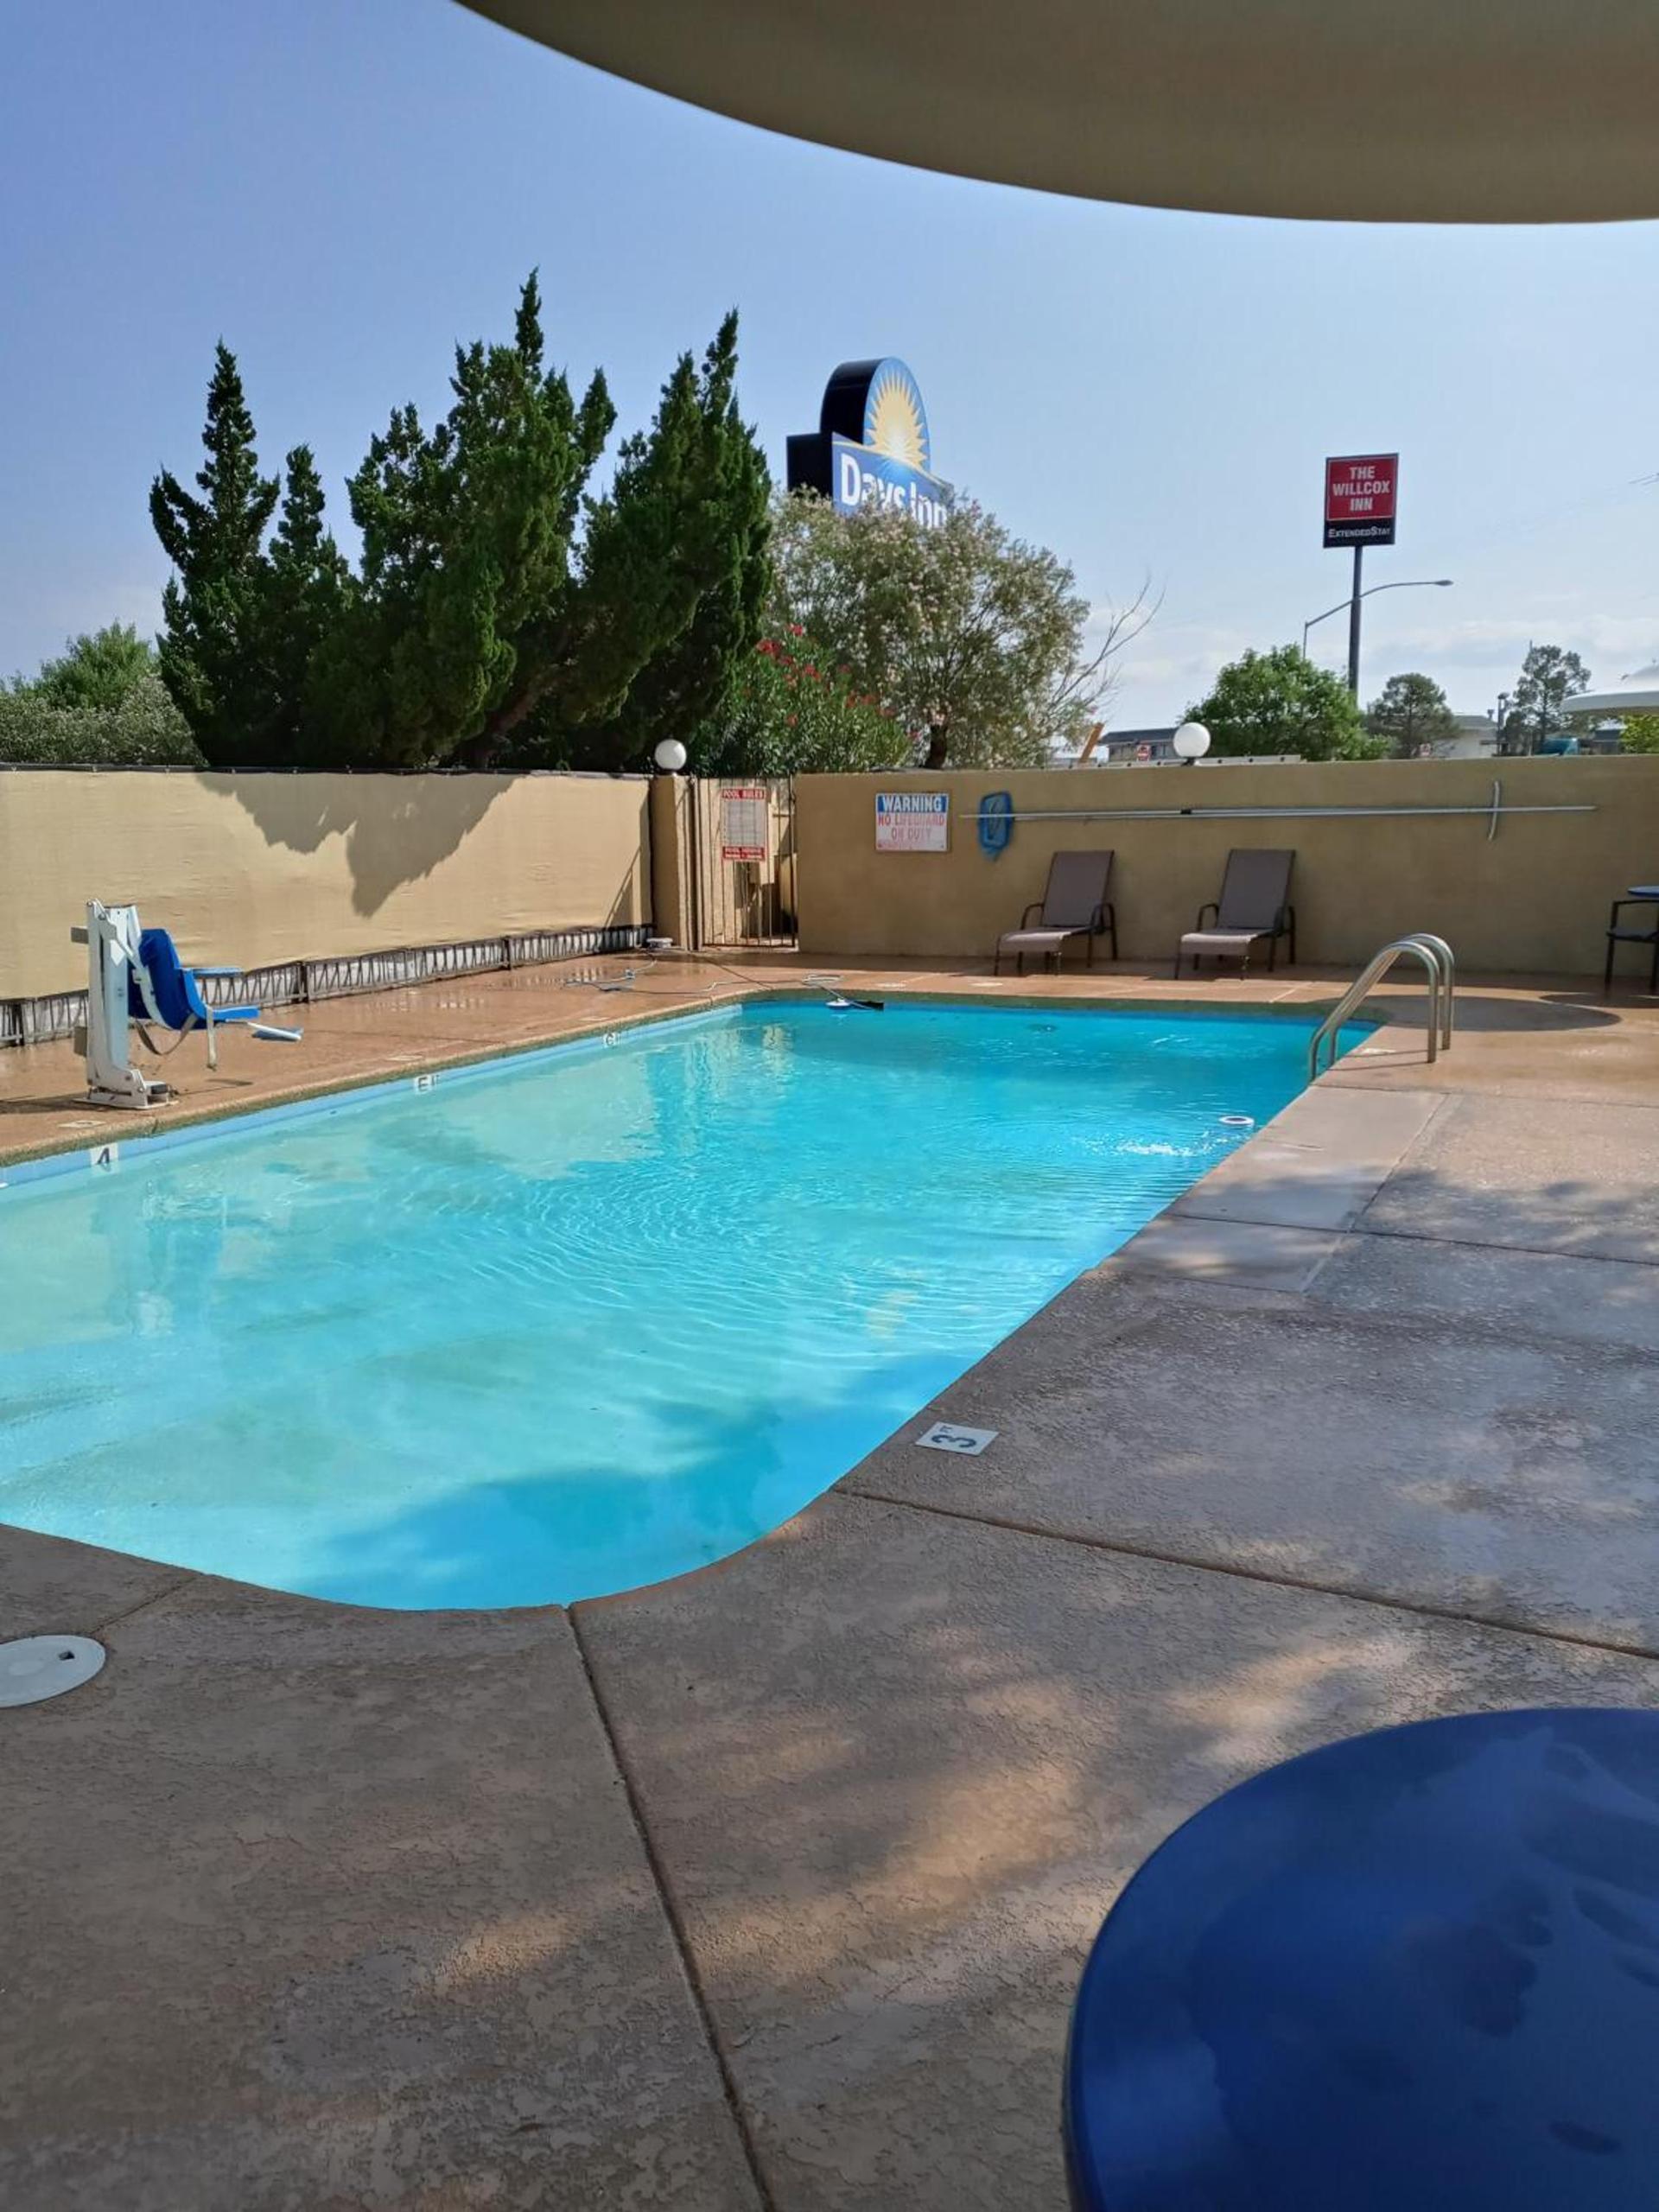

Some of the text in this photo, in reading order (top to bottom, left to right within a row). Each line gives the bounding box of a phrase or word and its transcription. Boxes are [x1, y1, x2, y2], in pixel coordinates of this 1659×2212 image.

[1349, 466, 1376, 480] THE
[1332, 480, 1390, 496] WILLCOX
[1350, 497, 1373, 512] INN
[884, 796, 942, 812] WARNING
[879, 814, 891, 826] NO
[931, 1435, 977, 1448] 3
